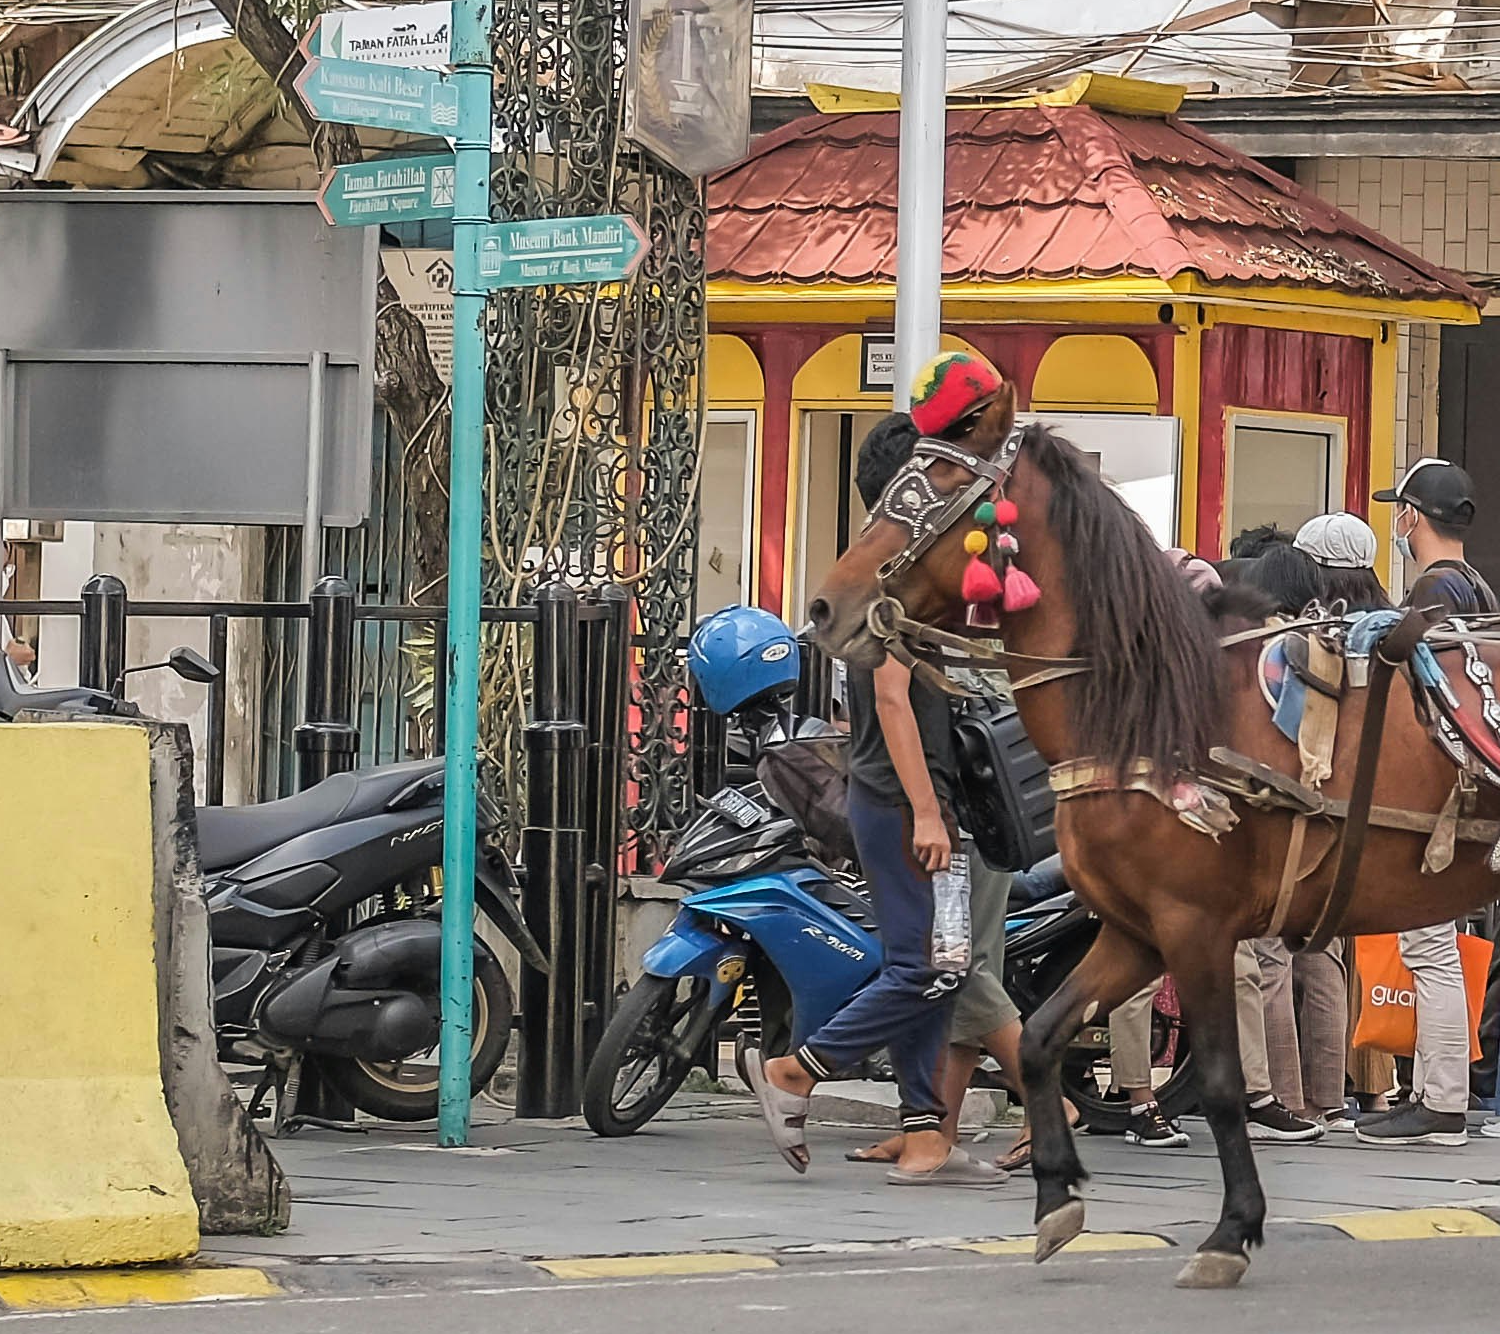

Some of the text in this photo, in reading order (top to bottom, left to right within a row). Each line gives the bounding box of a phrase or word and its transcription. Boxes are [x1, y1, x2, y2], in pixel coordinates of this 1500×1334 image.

[349, 38, 384, 52] TAMAN
[321, 66, 424, 97] Kawasan Kali Besar
[389, 107, 411, 121] Area
[343, 166, 426, 192] Taman Fatahillah
[509, 224, 624, 251] Museum Bank Mandiri
